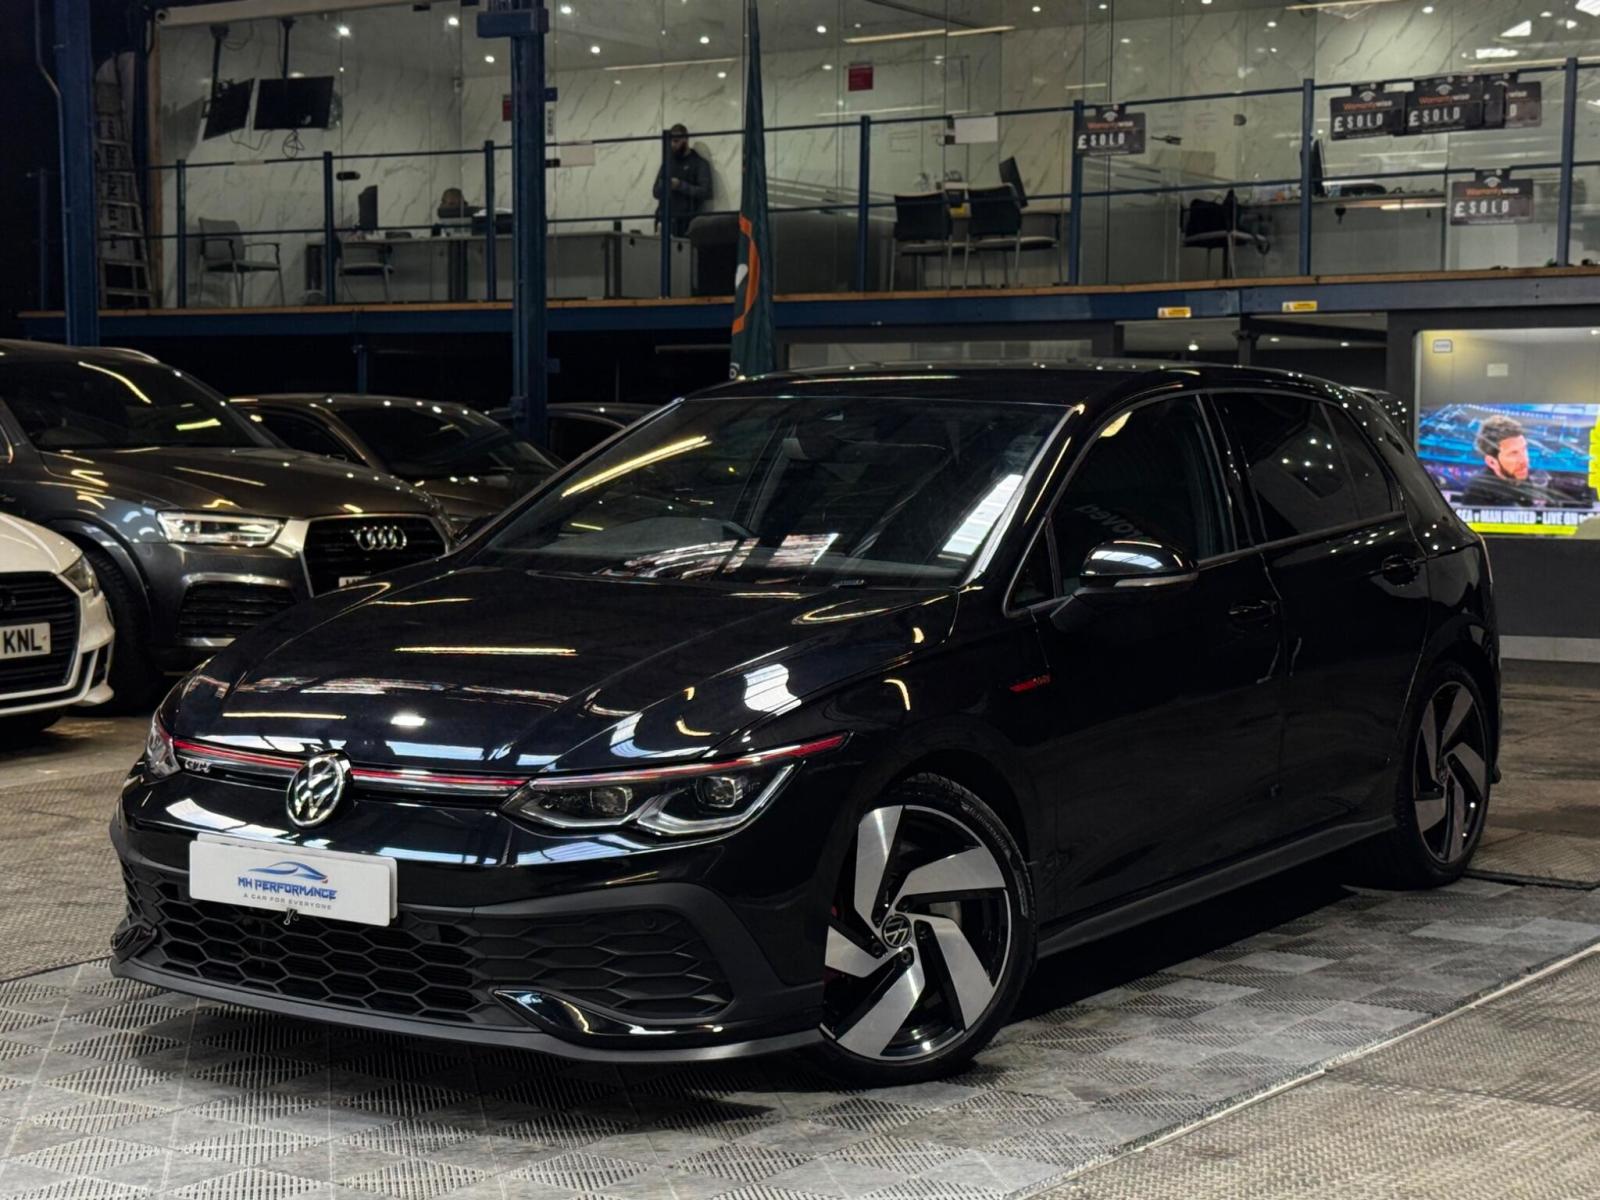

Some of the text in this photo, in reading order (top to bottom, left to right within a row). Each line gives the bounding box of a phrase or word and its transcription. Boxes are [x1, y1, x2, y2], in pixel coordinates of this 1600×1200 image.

[3, 628, 43, 654] KNL
[237, 877, 338, 900] MH PERFORMANCE
[288, 899, 333, 910] EVERYONE
